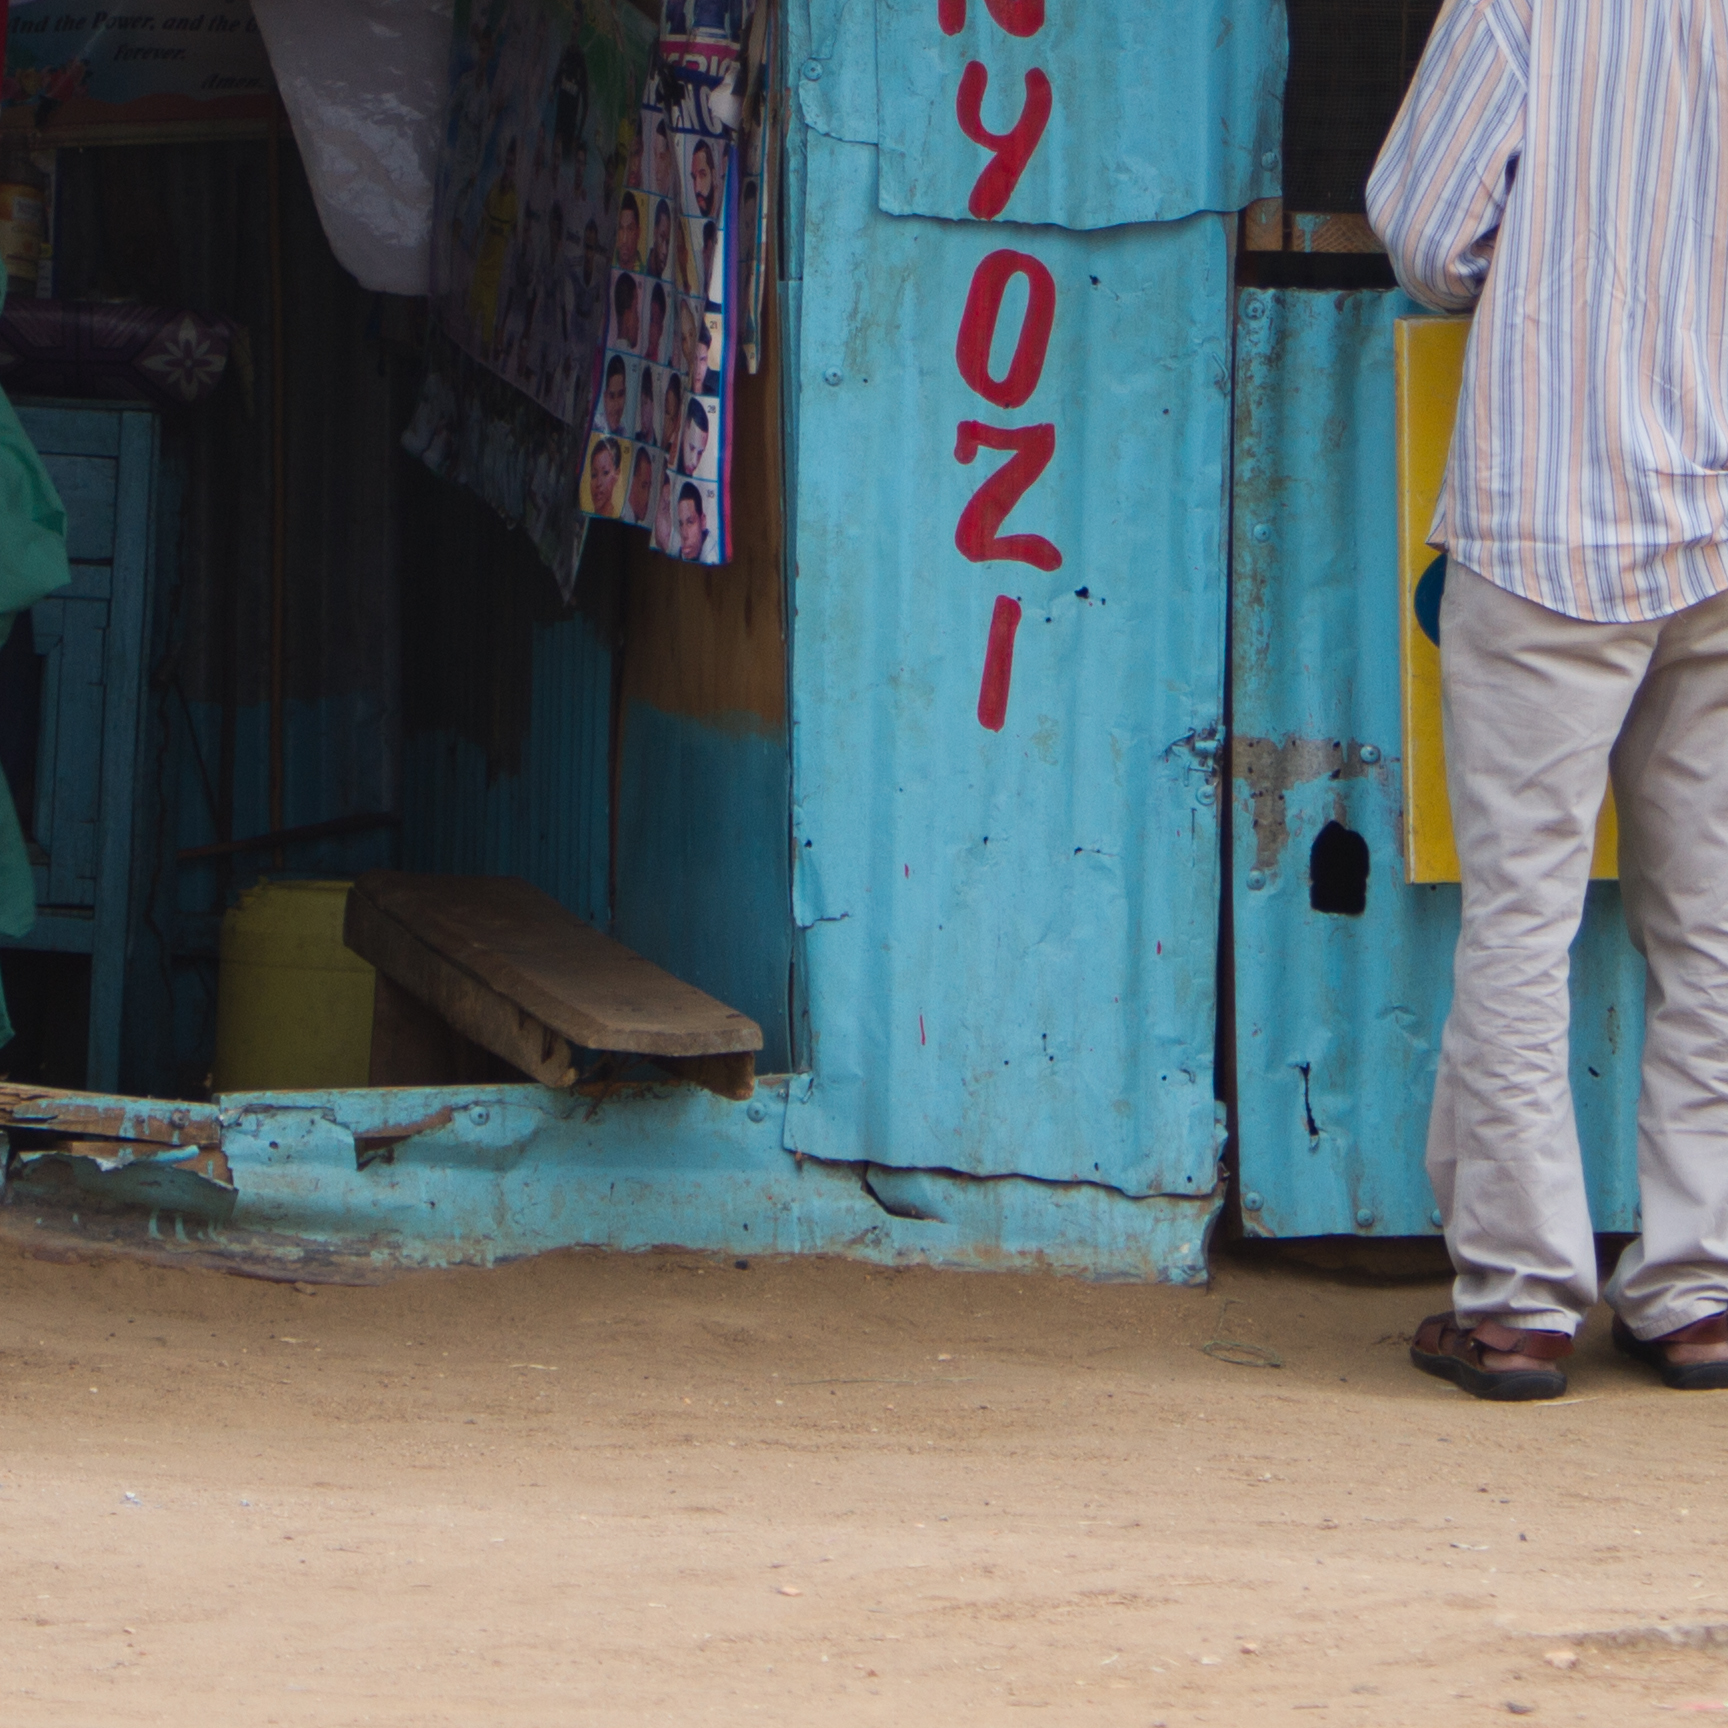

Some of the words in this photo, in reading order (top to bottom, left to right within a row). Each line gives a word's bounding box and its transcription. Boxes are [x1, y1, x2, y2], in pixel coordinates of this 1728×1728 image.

[54, 14, 86, 31] the
[162, 15, 204, 31] and
[207, 15, 239, 33] the
